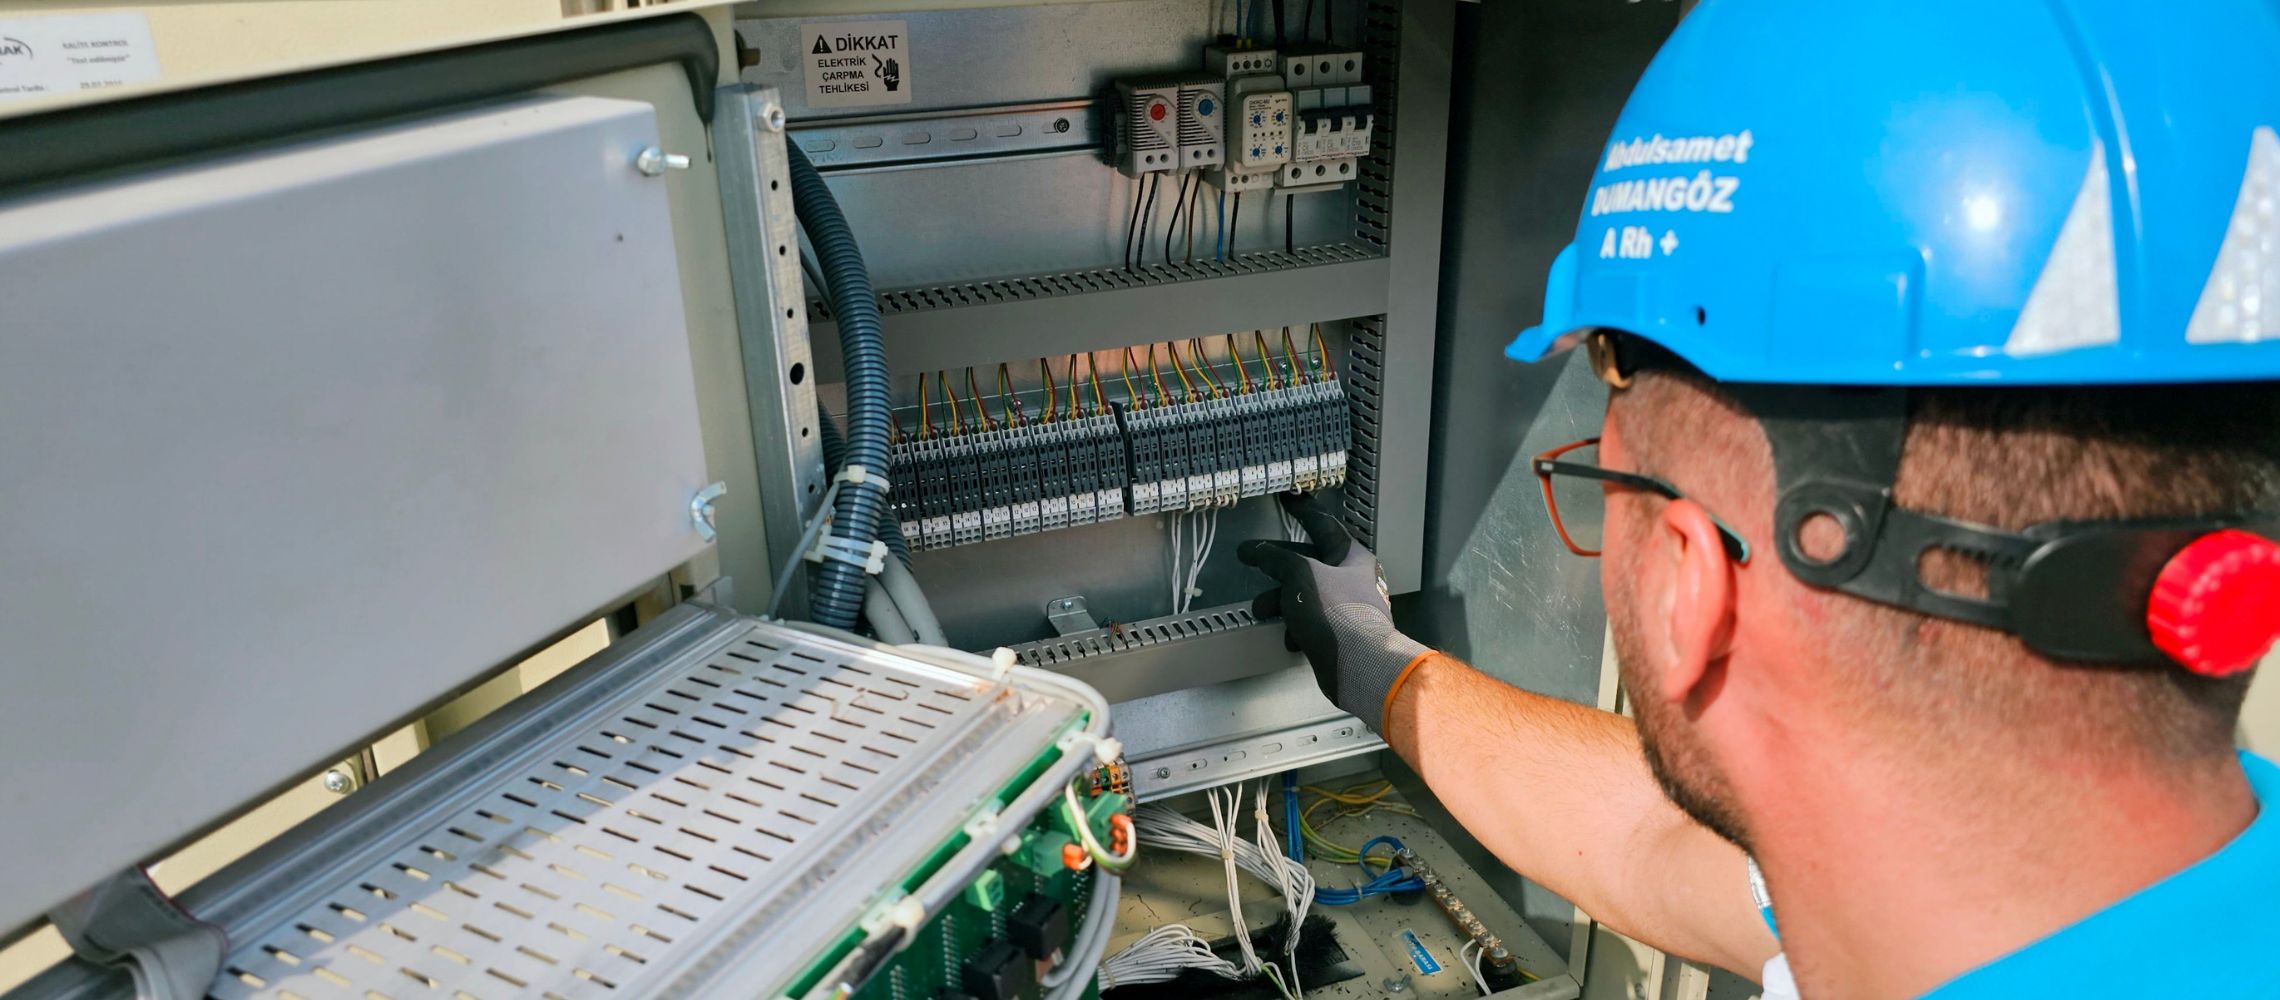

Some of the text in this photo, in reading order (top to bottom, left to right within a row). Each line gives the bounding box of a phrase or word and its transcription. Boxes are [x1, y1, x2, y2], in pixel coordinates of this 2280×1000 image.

[835, 33, 899, 52] DİKKAT
[817, 56, 867, 68] ELEKTRİK
[821, 70, 865, 82] ÇARPMA
[818, 81, 870, 94] TEHLİKESİ
[1603, 128, 1754, 172] Abdulsamet
[1590, 169, 1740, 217] DUMANGÖZ
[1599, 226, 1617, 259] A
[1618, 225, 1654, 259] Rh
